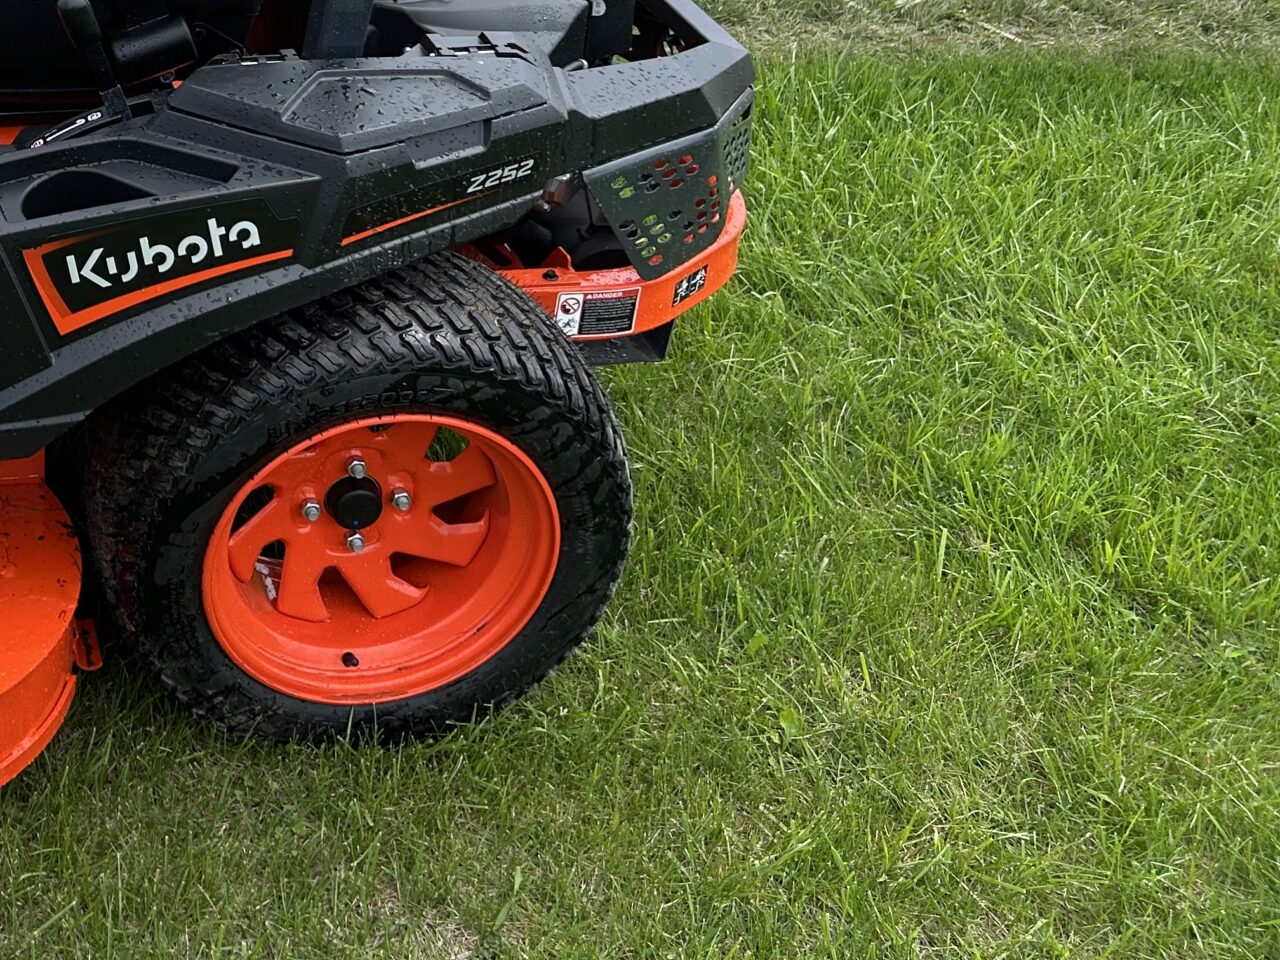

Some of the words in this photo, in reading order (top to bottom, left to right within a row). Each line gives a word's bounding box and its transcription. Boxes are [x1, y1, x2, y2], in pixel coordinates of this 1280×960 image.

[466, 159, 535, 195] Z252
[66, 217, 261, 289] Kubota
[593, 291, 623, 299] DANGER
